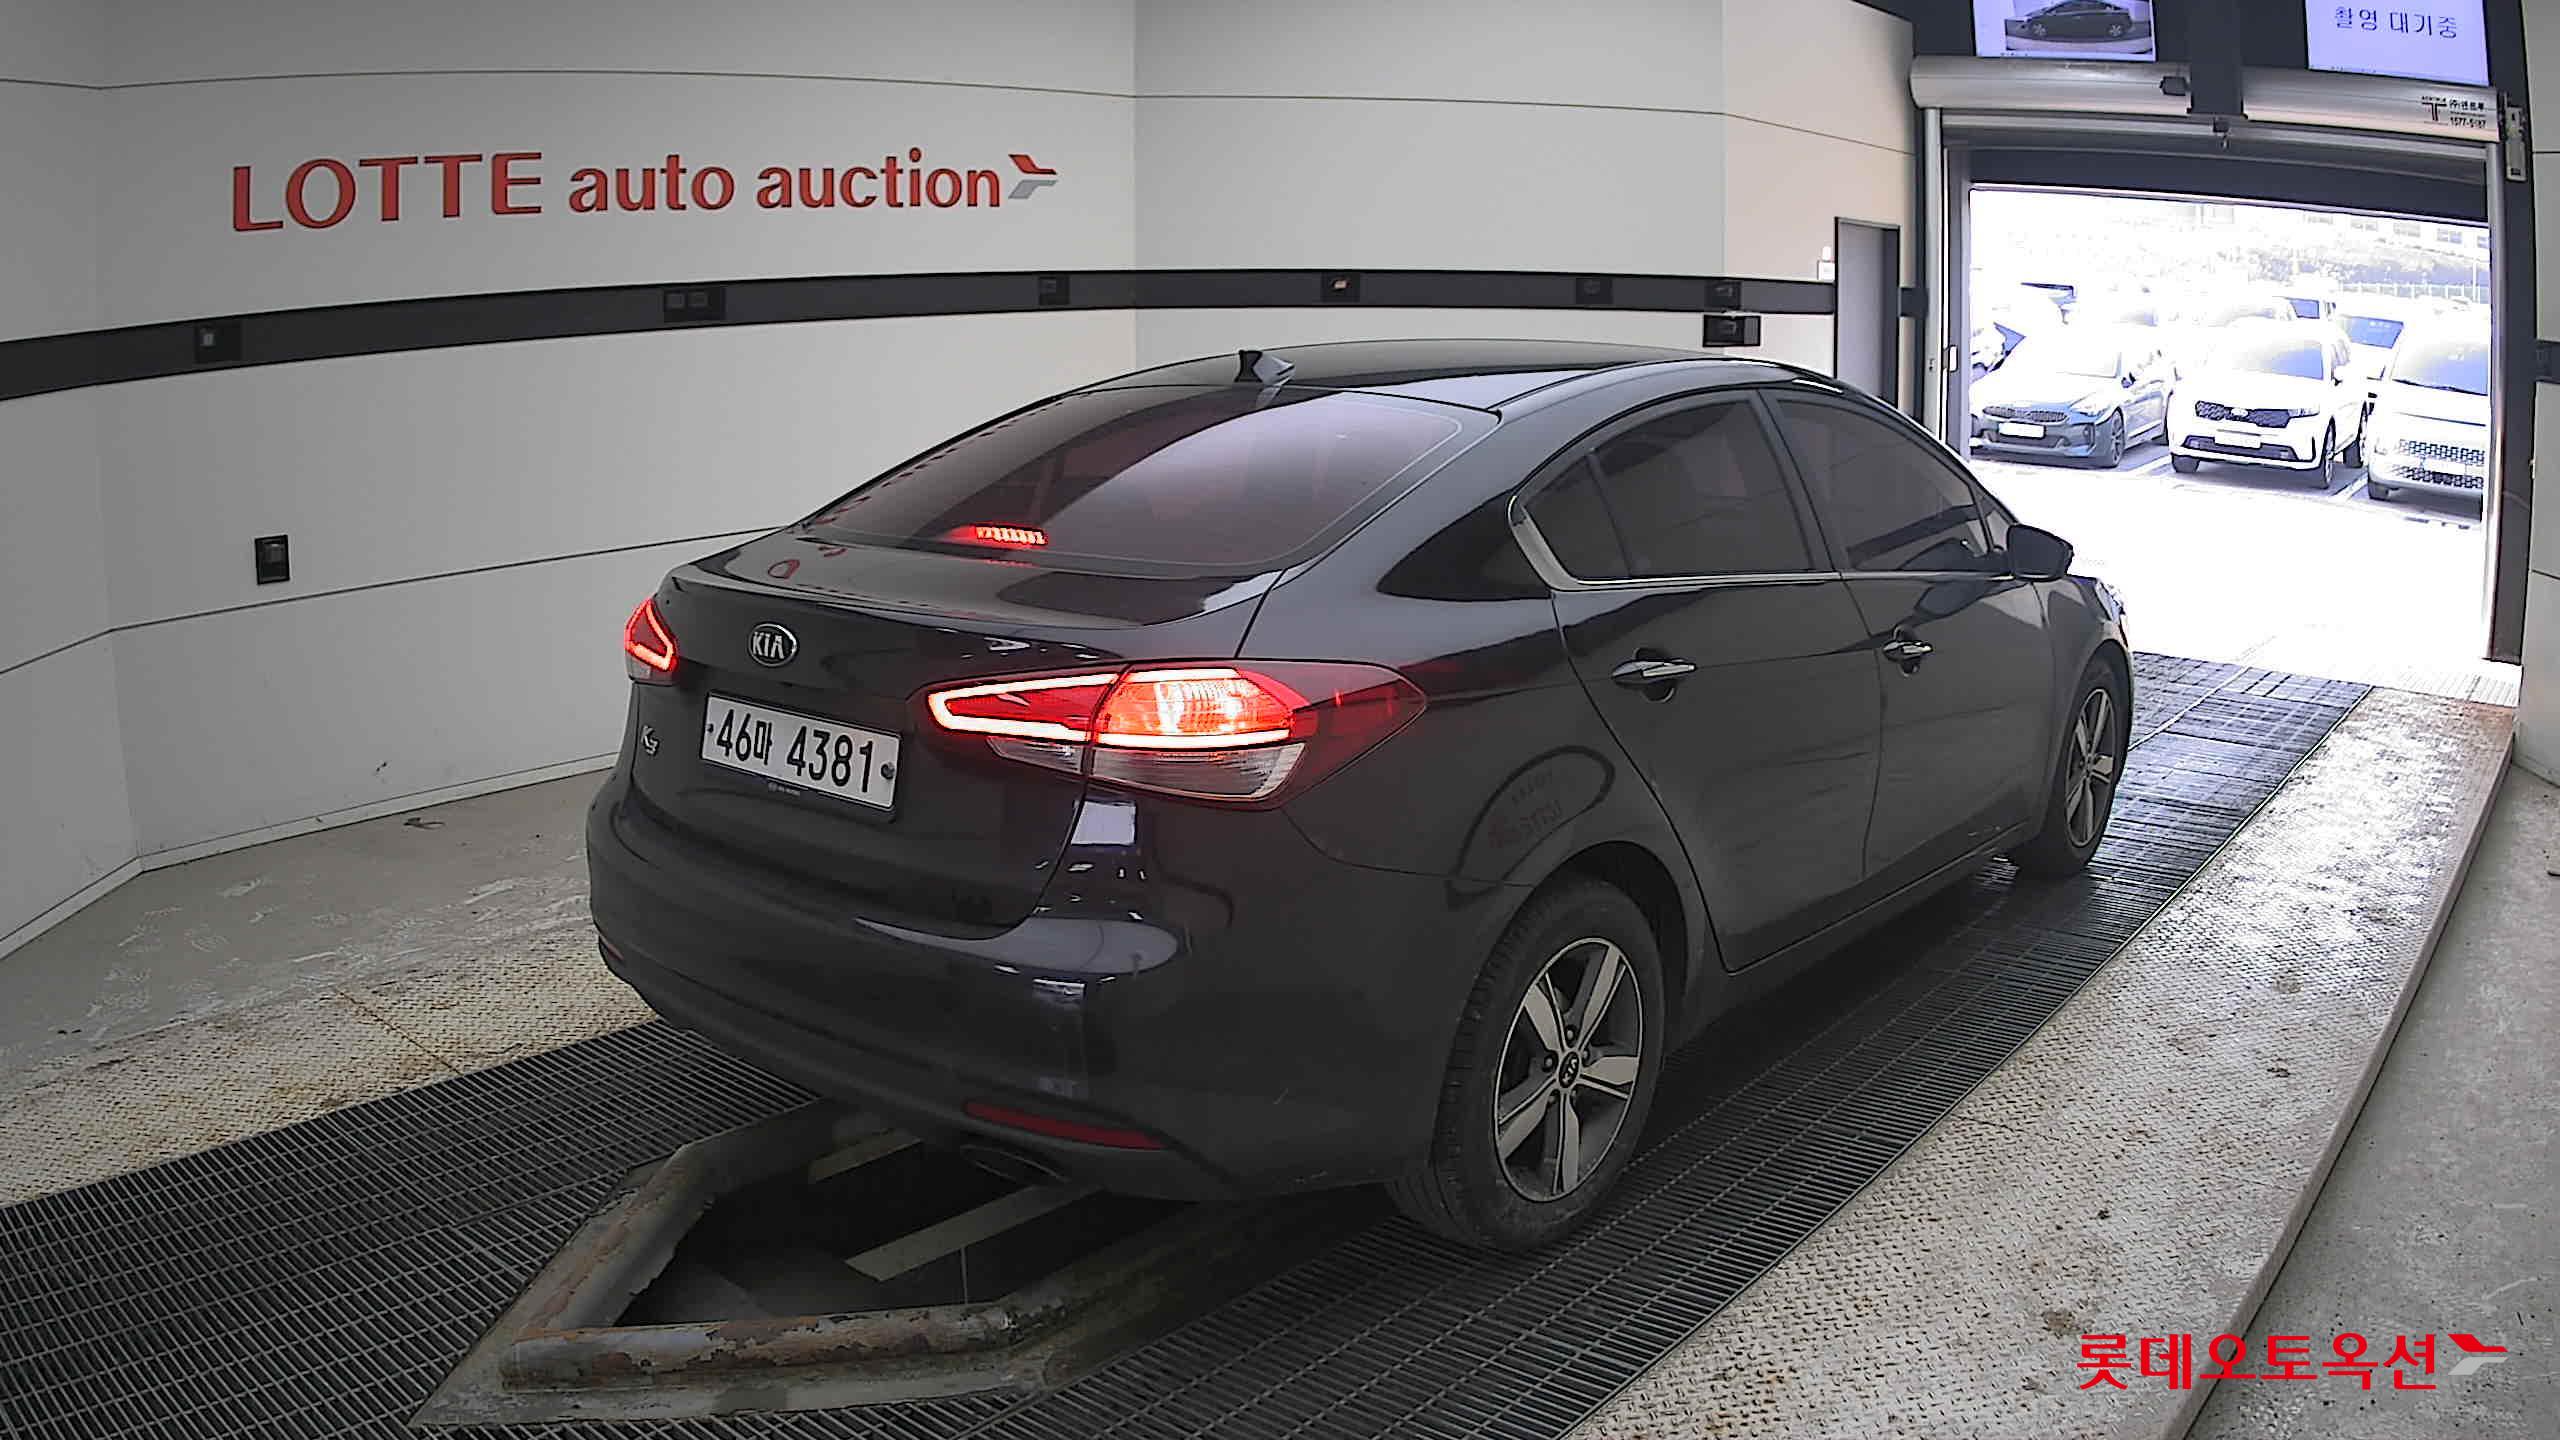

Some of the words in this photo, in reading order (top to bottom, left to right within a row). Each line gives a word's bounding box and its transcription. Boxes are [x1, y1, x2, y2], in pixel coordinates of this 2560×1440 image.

[232, 151, 542, 232] LOTTE
[569, 154, 735, 212] auto
[756, 147, 1001, 210] auction
[752, 631, 785, 659] KIA
[716, 709, 773, 766] 46마
[786, 726, 874, 793] 4381
